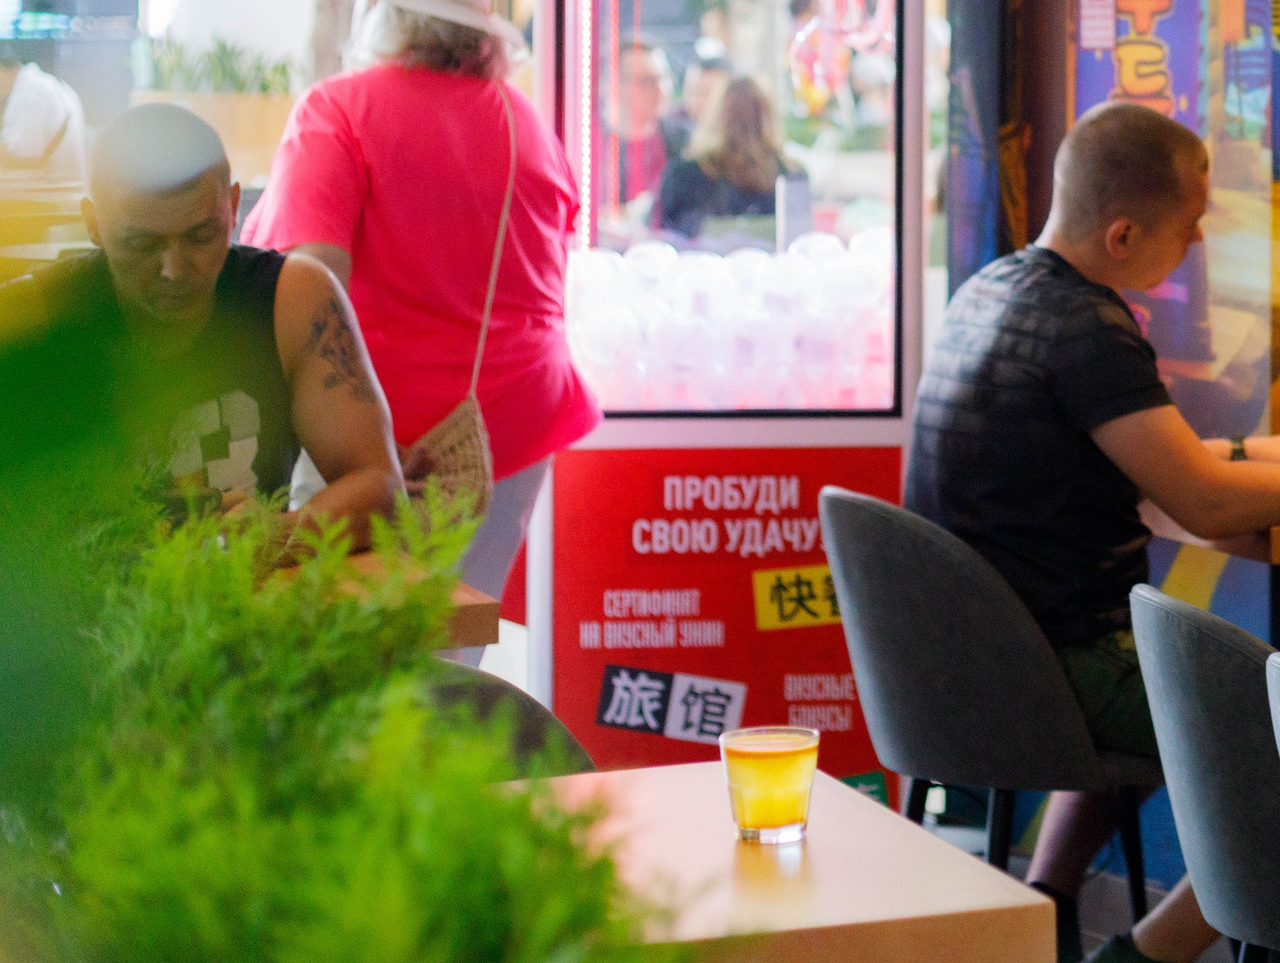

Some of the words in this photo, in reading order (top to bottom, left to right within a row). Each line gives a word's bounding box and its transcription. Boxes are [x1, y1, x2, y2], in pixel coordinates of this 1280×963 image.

[664, 474, 800, 515] ПРОБУДИ
[632, 518, 719, 554] СВОЮ
[604, 670, 732, 737] 旅馆
